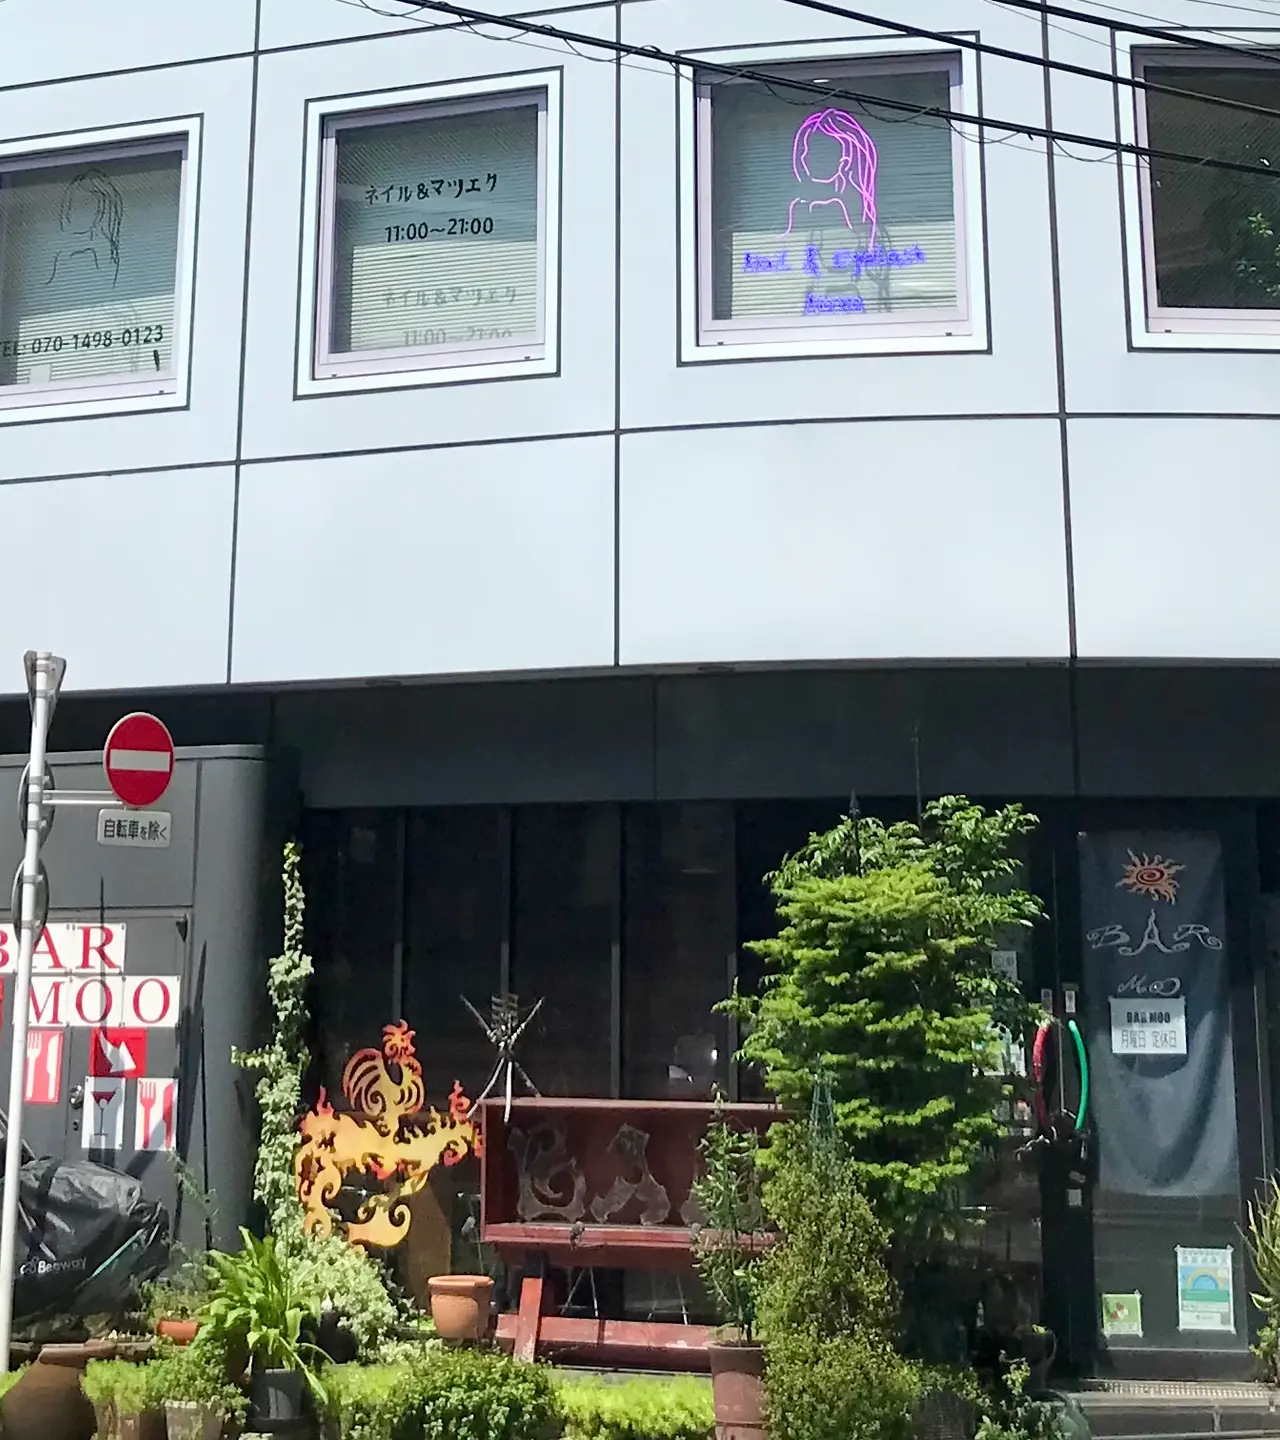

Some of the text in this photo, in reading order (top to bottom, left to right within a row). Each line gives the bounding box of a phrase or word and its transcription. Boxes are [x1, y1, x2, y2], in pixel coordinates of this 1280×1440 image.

[32, 325, 164, 354] 070-1498-0123
[103, 818, 168, 841] 自転車を除く
[1086, 908, 1224, 957] BAR
[29, 977, 171, 1025] MOO
[1150, 1011, 1171, 1023] MOO
